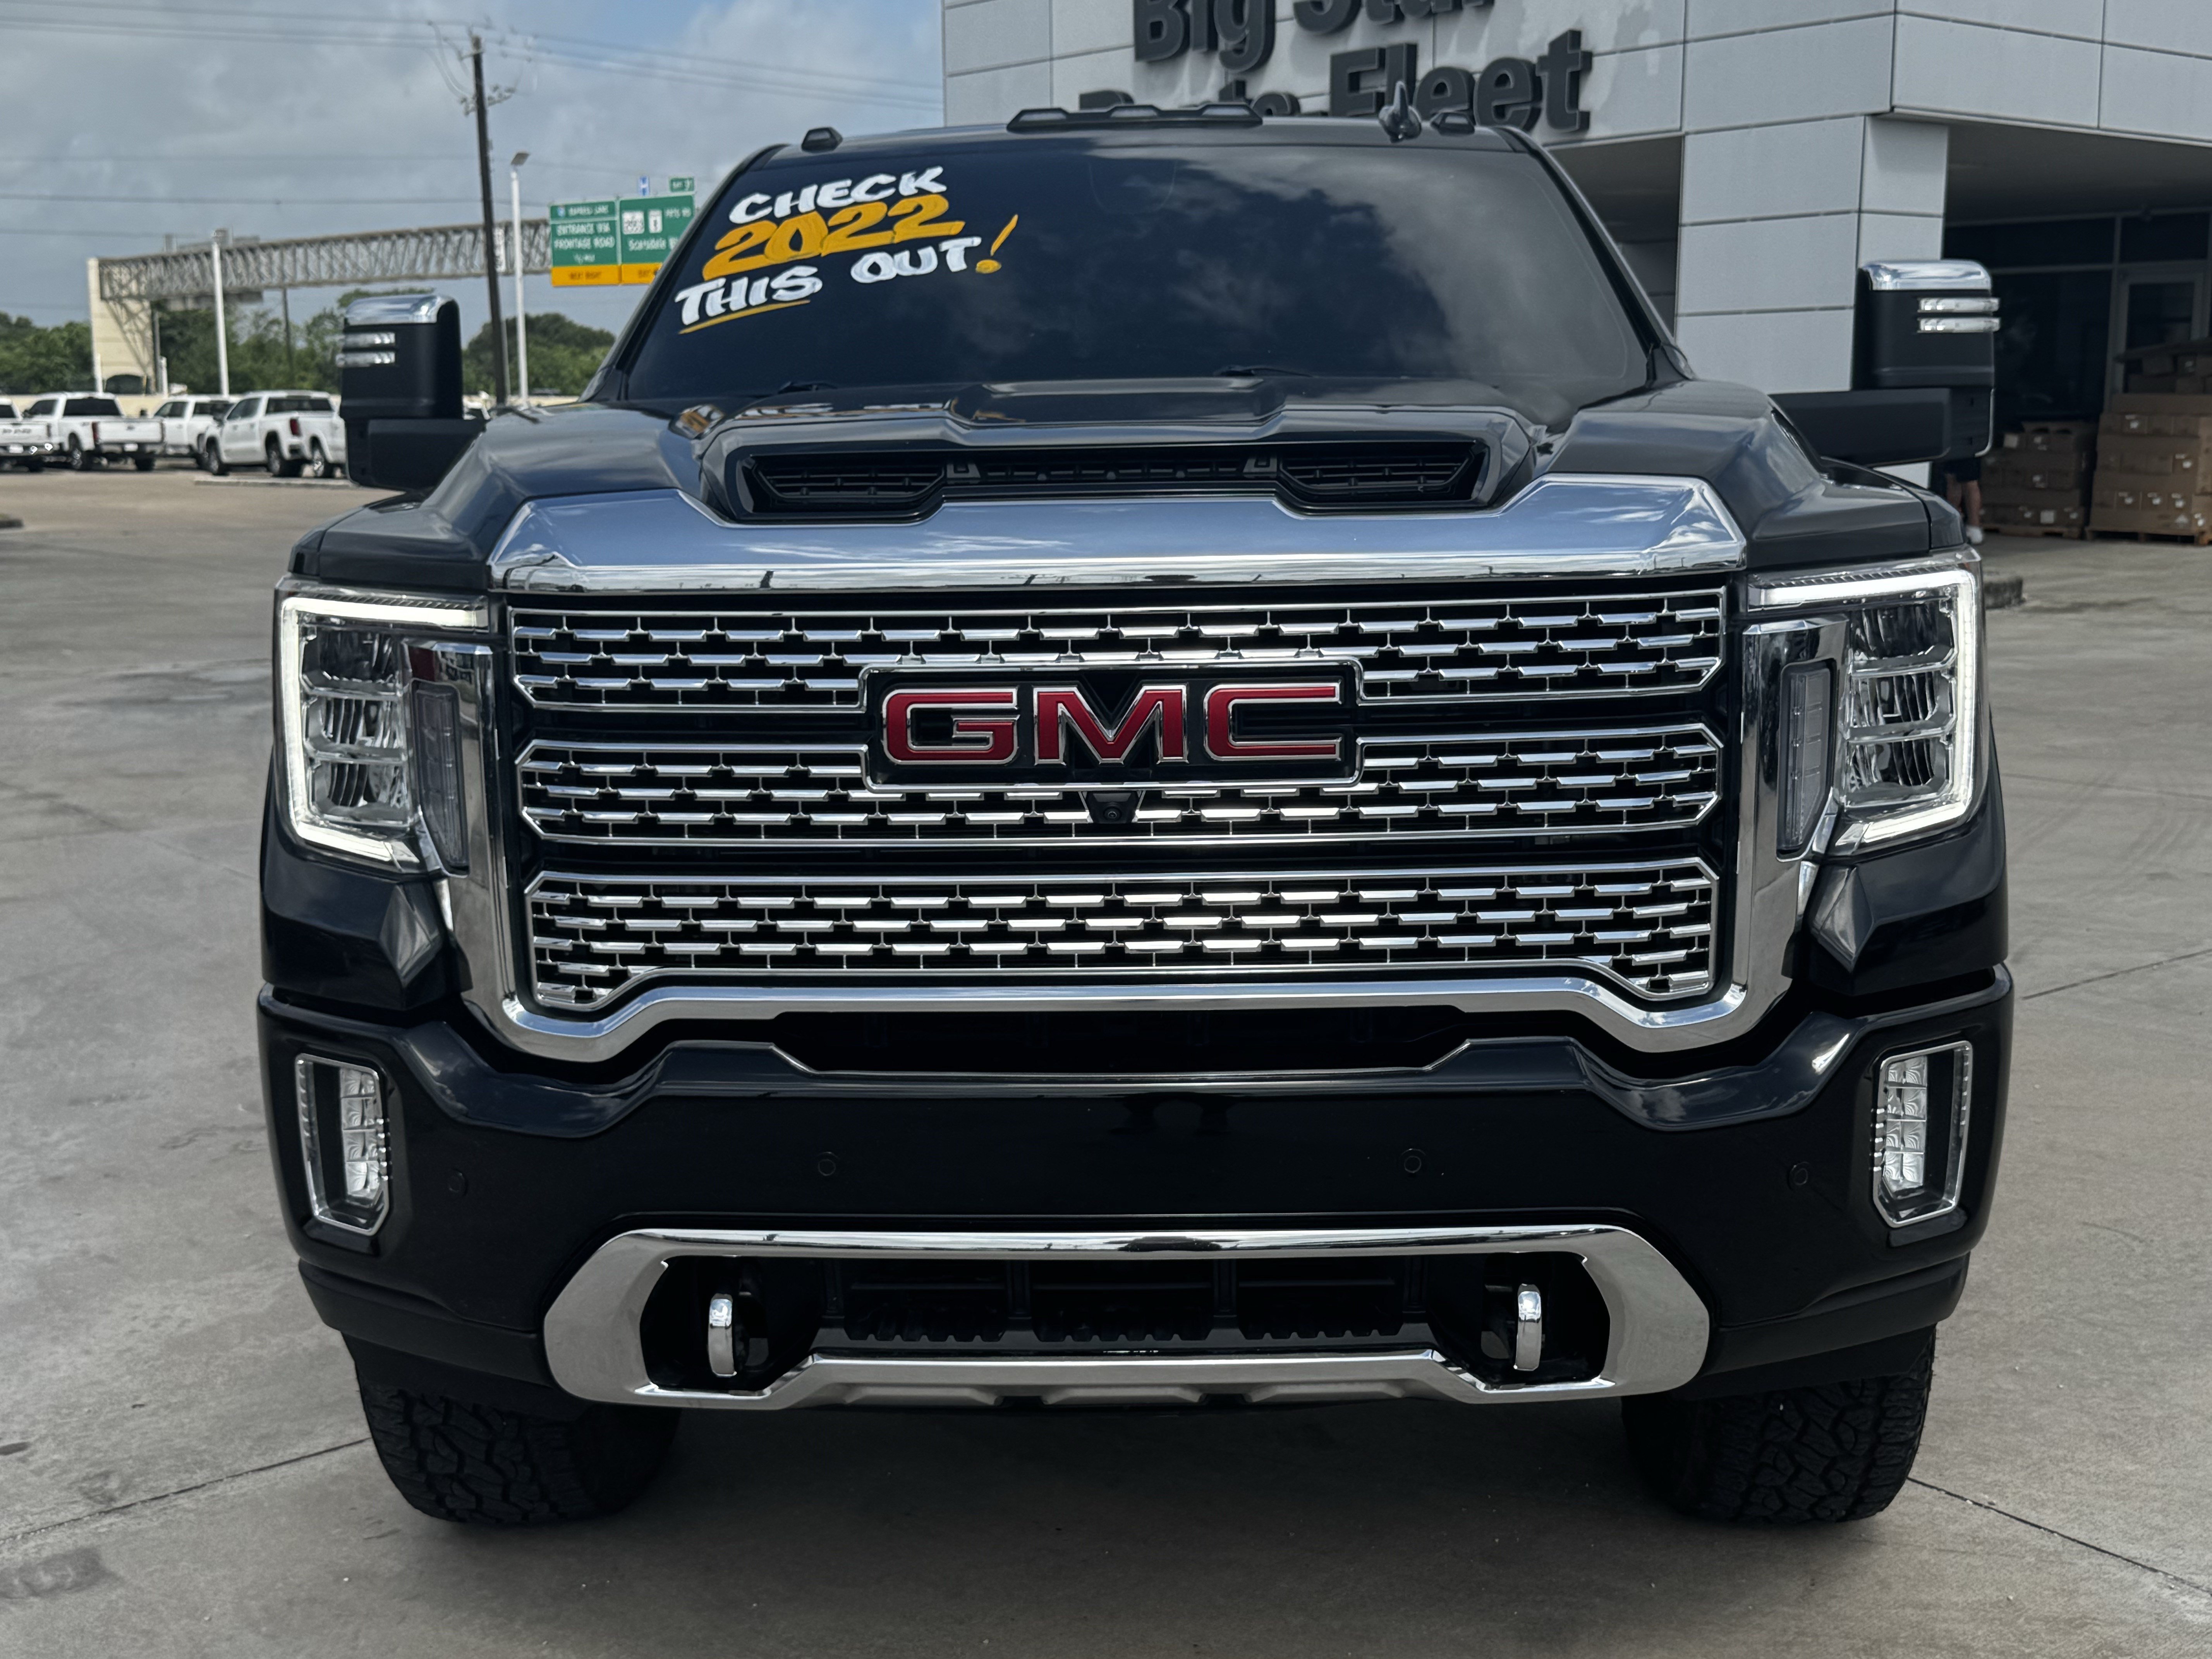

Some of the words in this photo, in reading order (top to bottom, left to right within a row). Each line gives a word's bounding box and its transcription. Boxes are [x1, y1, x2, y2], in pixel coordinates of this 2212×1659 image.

[1133, 0, 1276, 73] Big
[1330, 29, 1592, 132] Fleet
[729, 165, 947, 224] CHECK
[702, 194, 966, 281] 2022
[674, 265, 823, 325] THIS
[882, 680, 1345, 765] GMC
